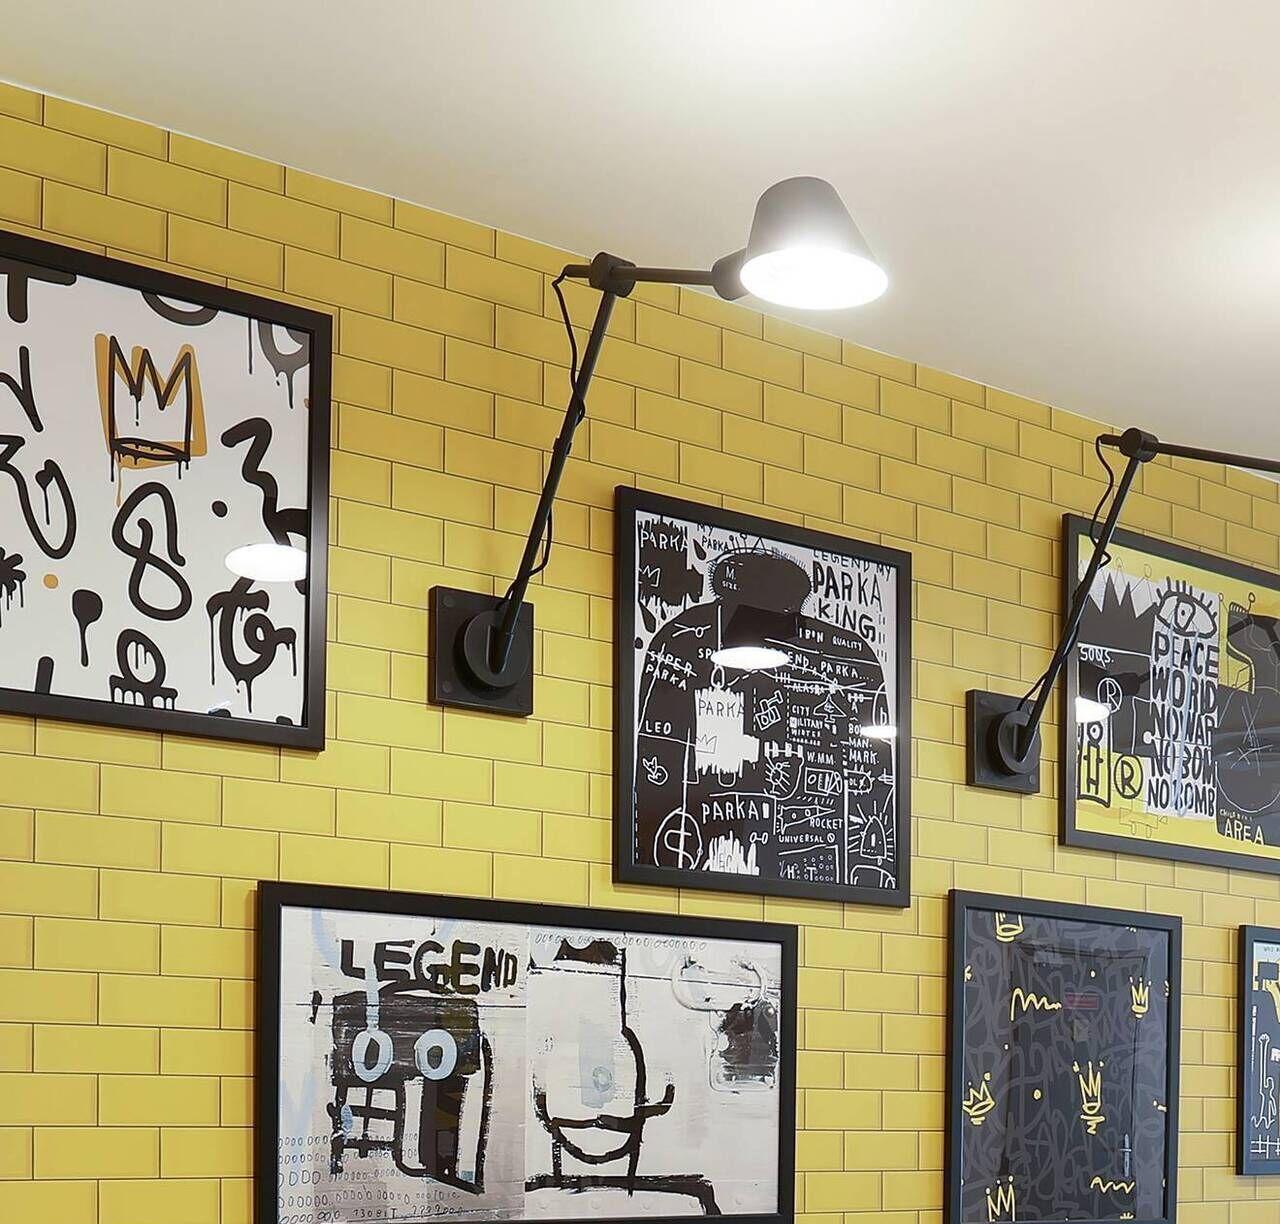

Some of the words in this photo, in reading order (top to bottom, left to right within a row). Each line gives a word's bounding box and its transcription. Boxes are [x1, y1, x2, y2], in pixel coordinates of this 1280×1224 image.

[640, 529, 689, 553] PARKA
[812, 560, 882, 613] PARKA
[818, 597, 876, 643] KING
[1154, 631, 1219, 678] PEACE
[645, 719, 672, 735] LEO
[701, 800, 760, 824] PARKA
[809, 818, 844, 830] ROCKET
[778, 834, 824, 844] UNIVERSAL
[1225, 817, 1264, 846] AREA
[340, 939, 518, 995] LEGEND
